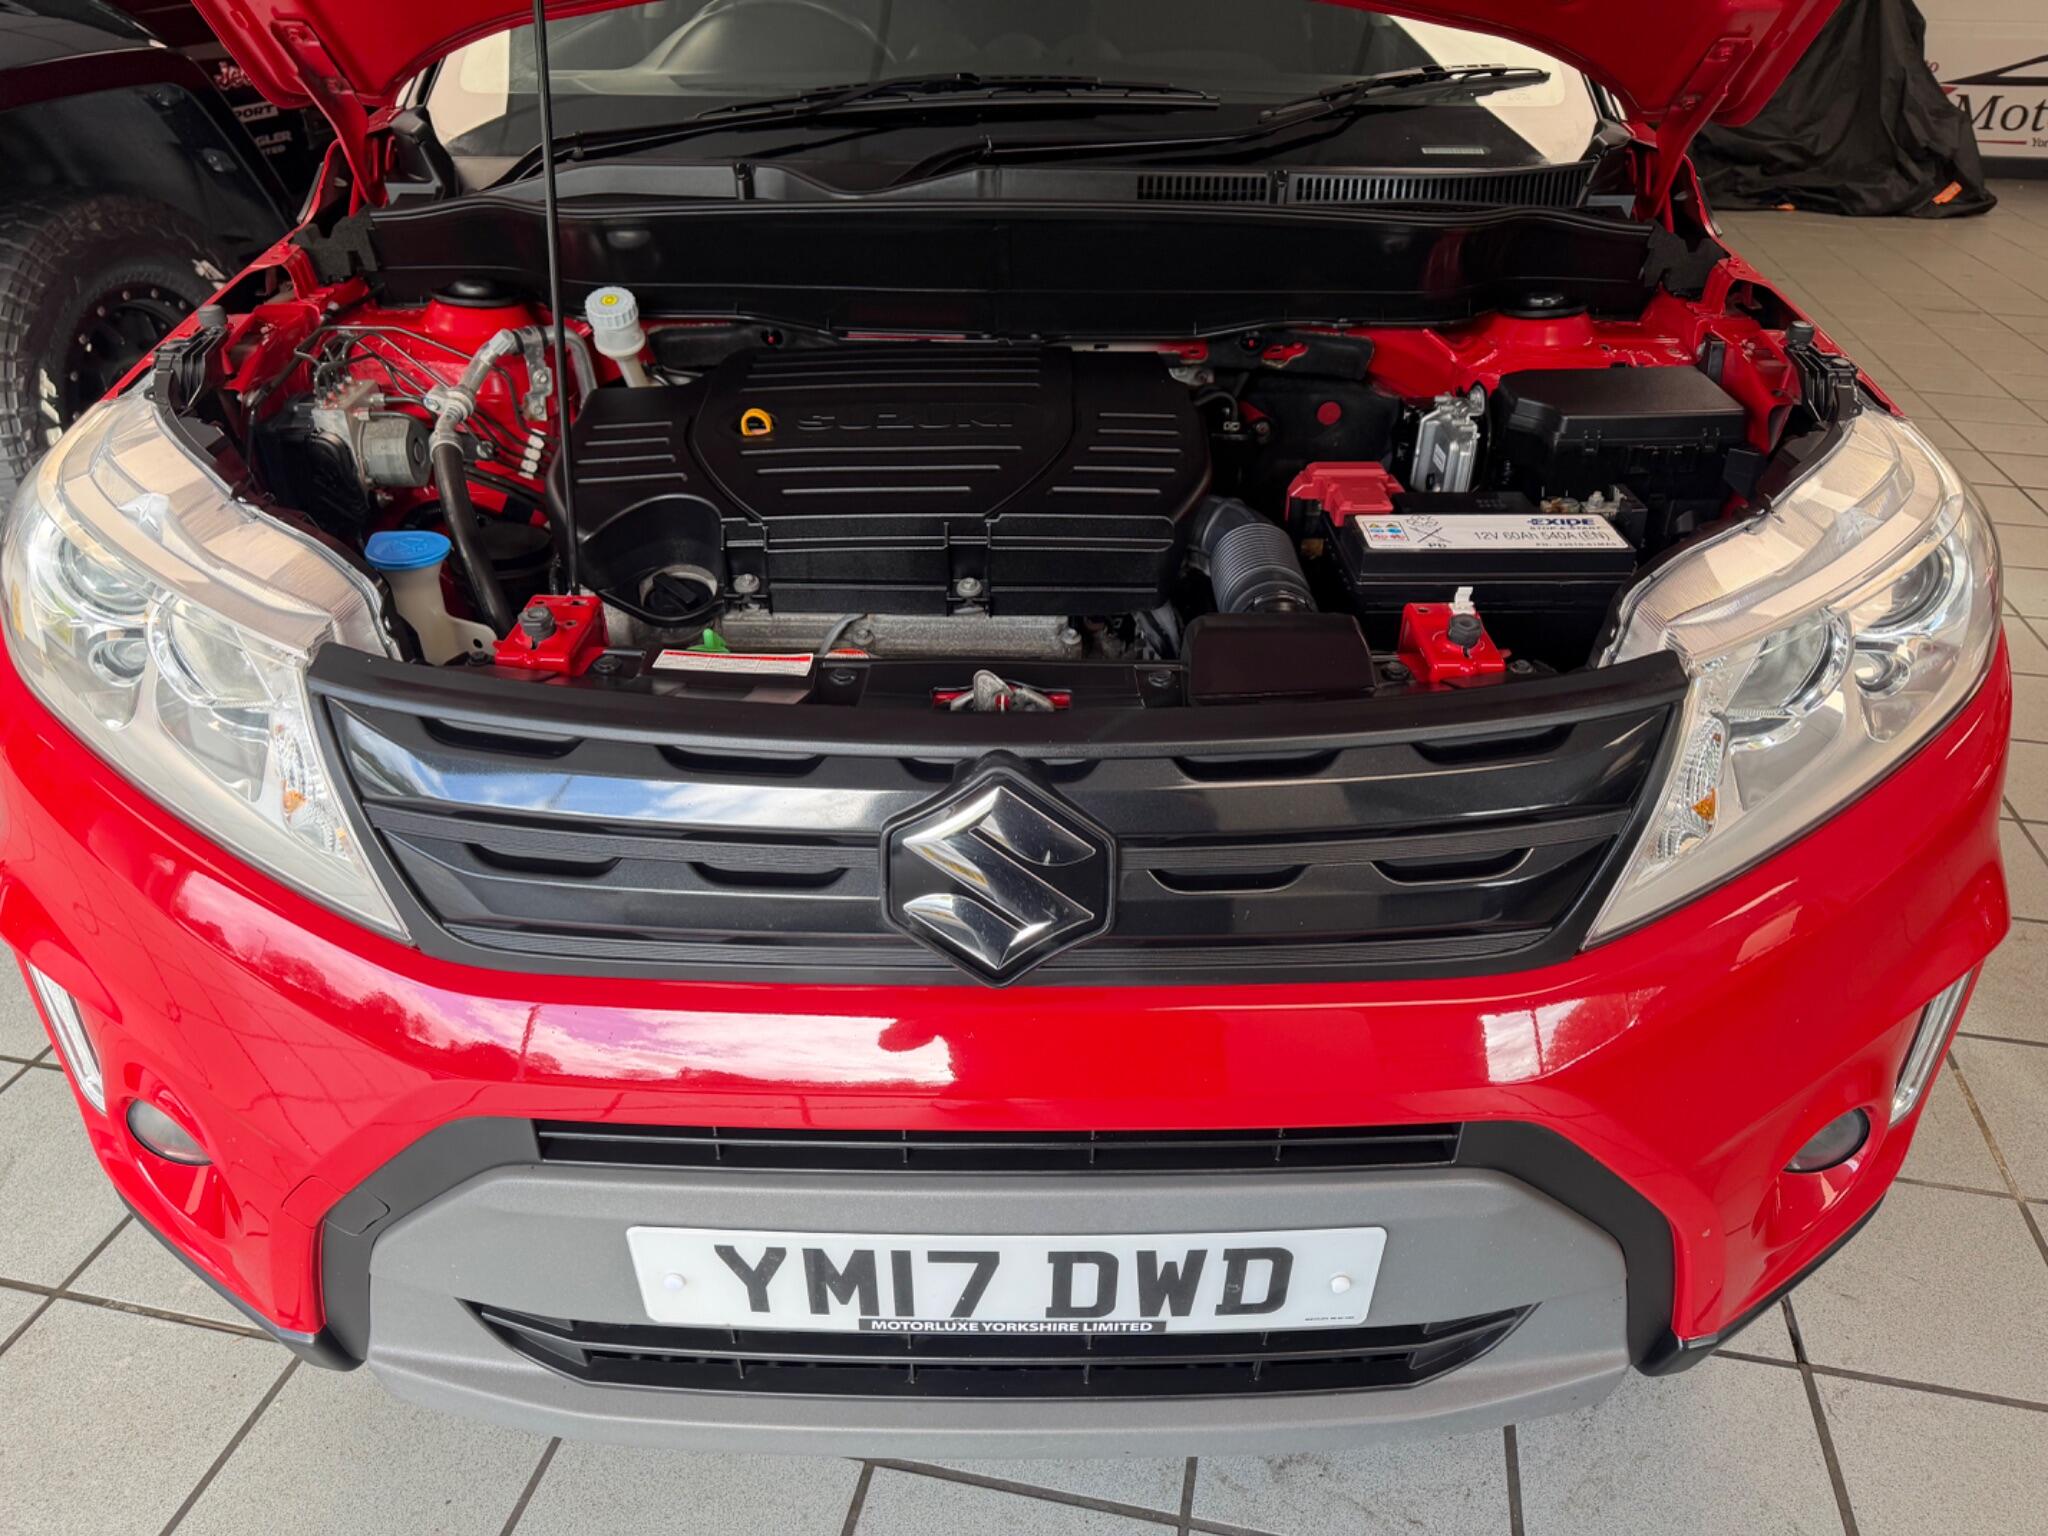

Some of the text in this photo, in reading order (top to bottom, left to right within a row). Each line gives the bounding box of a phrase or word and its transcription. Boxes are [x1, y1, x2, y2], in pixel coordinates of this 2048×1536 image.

[1528, 517, 1595, 526] EXIDE
[714, 1244, 1294, 1319] YM17 DWD
[871, 1319, 1153, 1333] MOTORLUXE YORKSHIRE LIMITED
